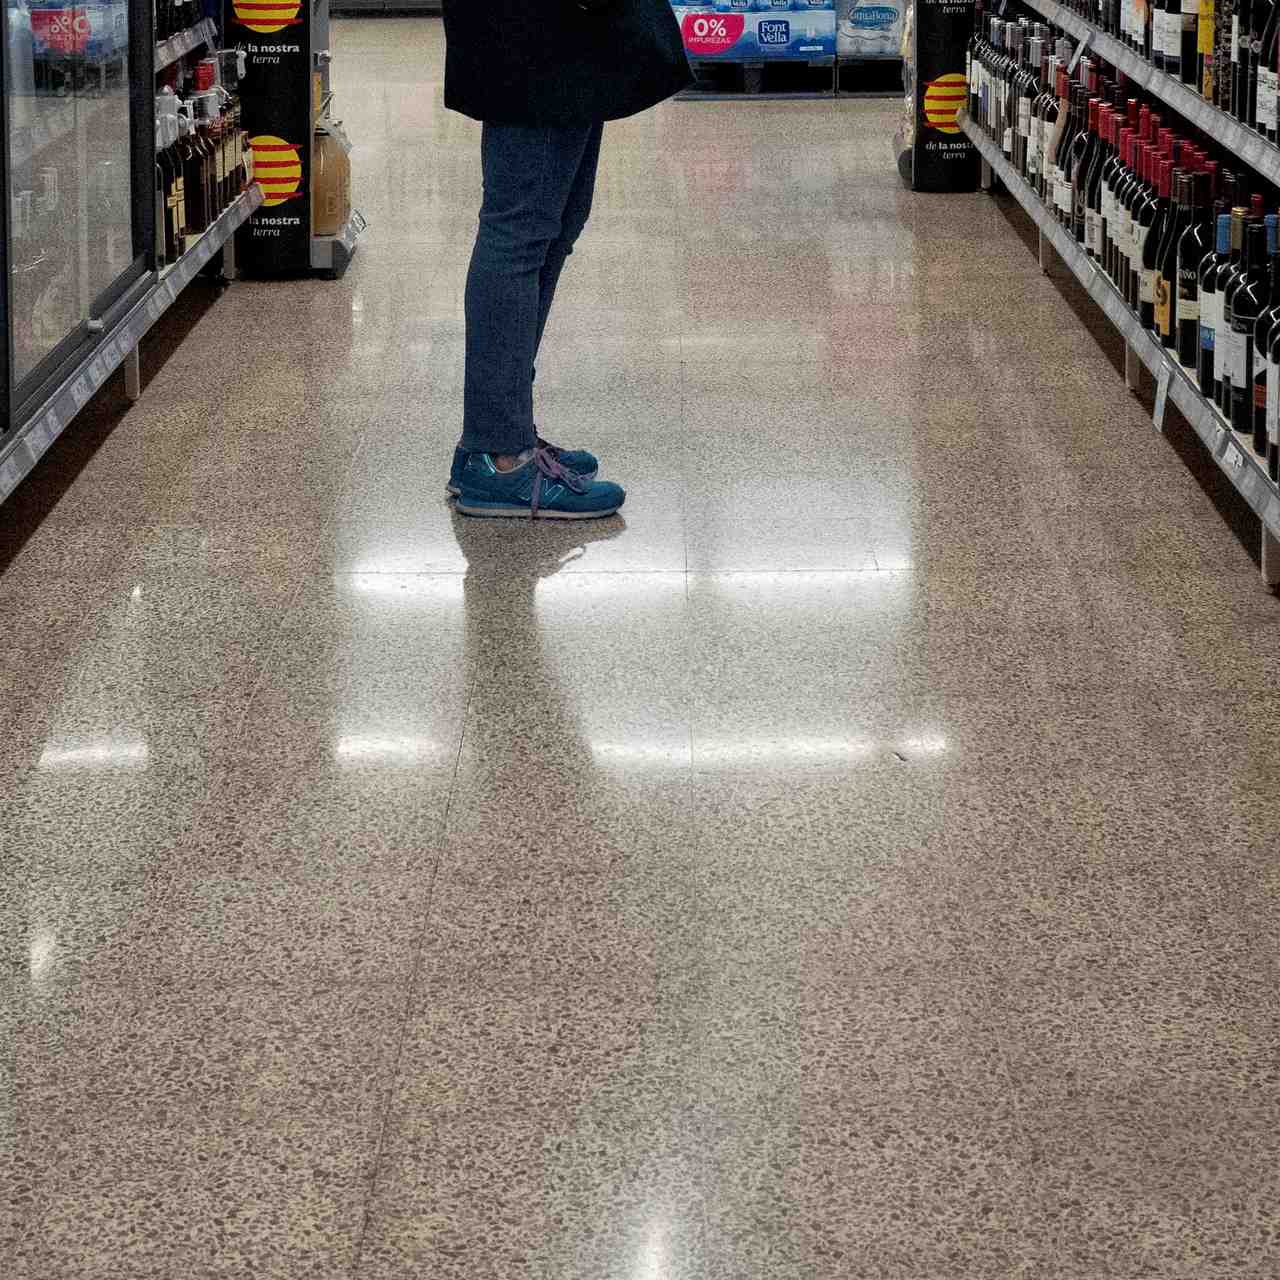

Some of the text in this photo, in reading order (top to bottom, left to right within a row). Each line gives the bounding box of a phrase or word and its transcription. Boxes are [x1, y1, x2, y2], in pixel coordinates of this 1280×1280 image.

[942, 5, 966, 14] terra
[693, 18, 727, 37] 0%
[760, 22, 787, 34] Font
[760, 31, 788, 44] Vella
[247, 42, 258, 53] la
[260, 44, 300, 54] nostra
[252, 54, 280, 64] terra
[938, 141, 948, 151] la
[261, 217, 300, 226] nostra
[252, 226, 280, 237] terra
